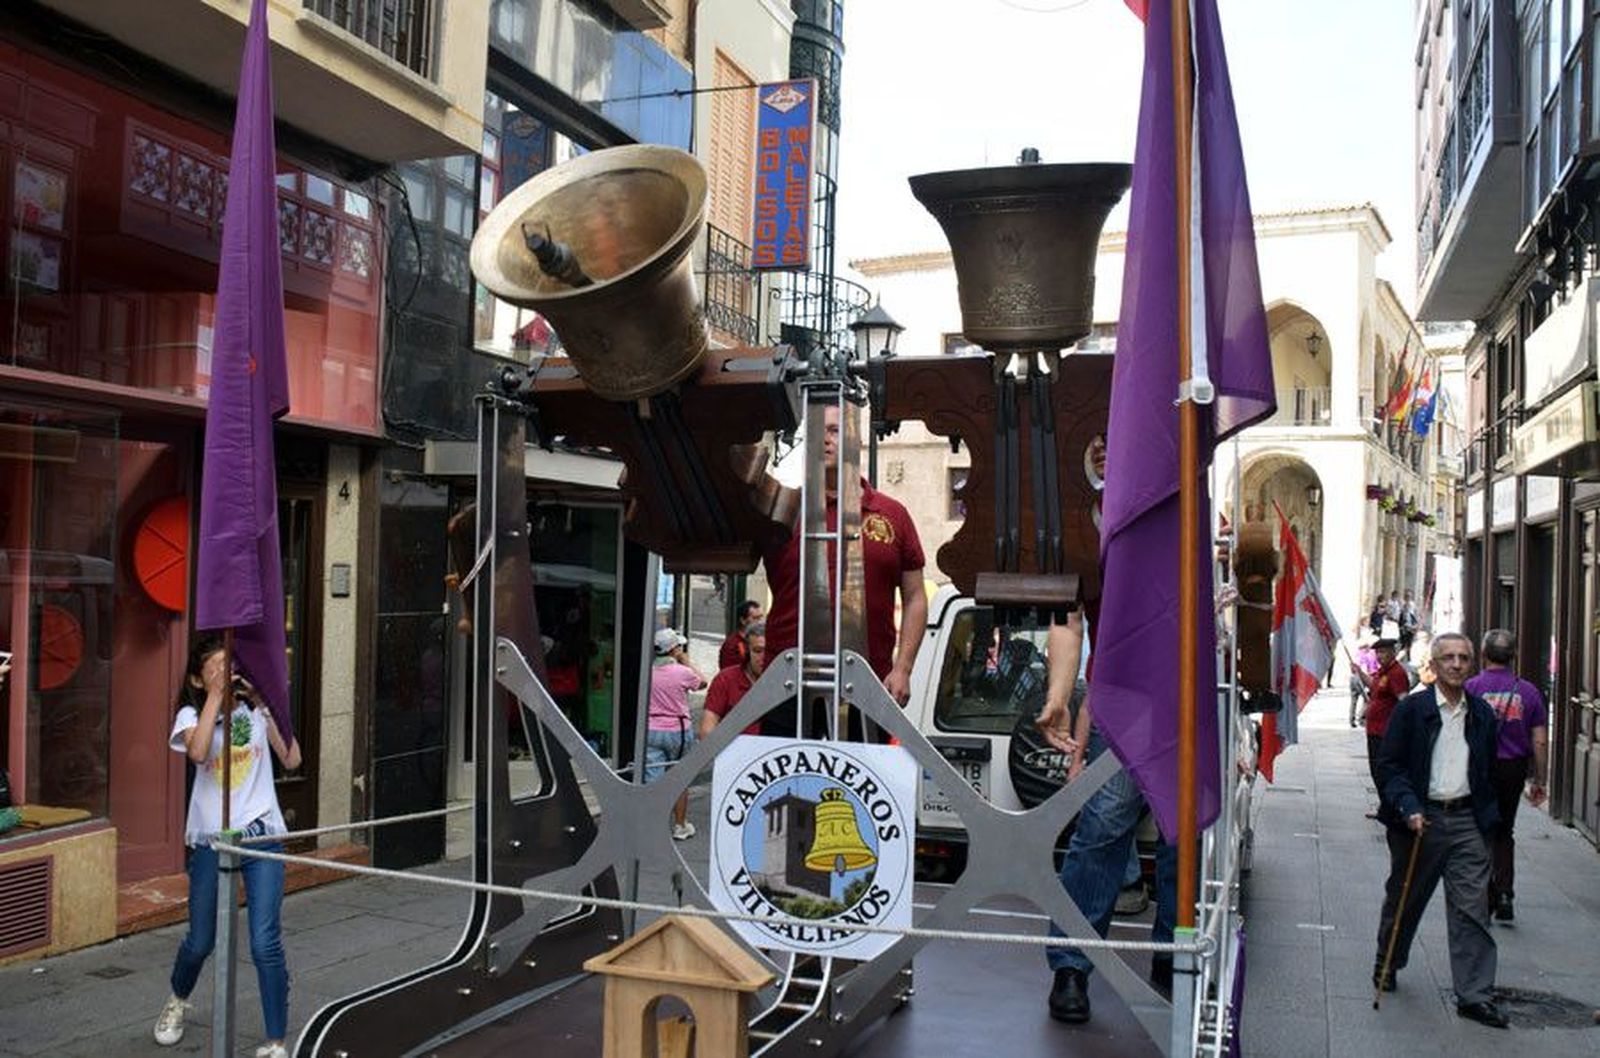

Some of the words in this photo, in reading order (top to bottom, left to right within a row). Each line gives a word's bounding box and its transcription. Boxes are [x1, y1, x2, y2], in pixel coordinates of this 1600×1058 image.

[756, 128, 780, 265] BOLSOS
[782, 127, 808, 265] MALETAS
[338, 480, 350, 501] 4
[726, 751, 900, 843] CAMPANEROS
